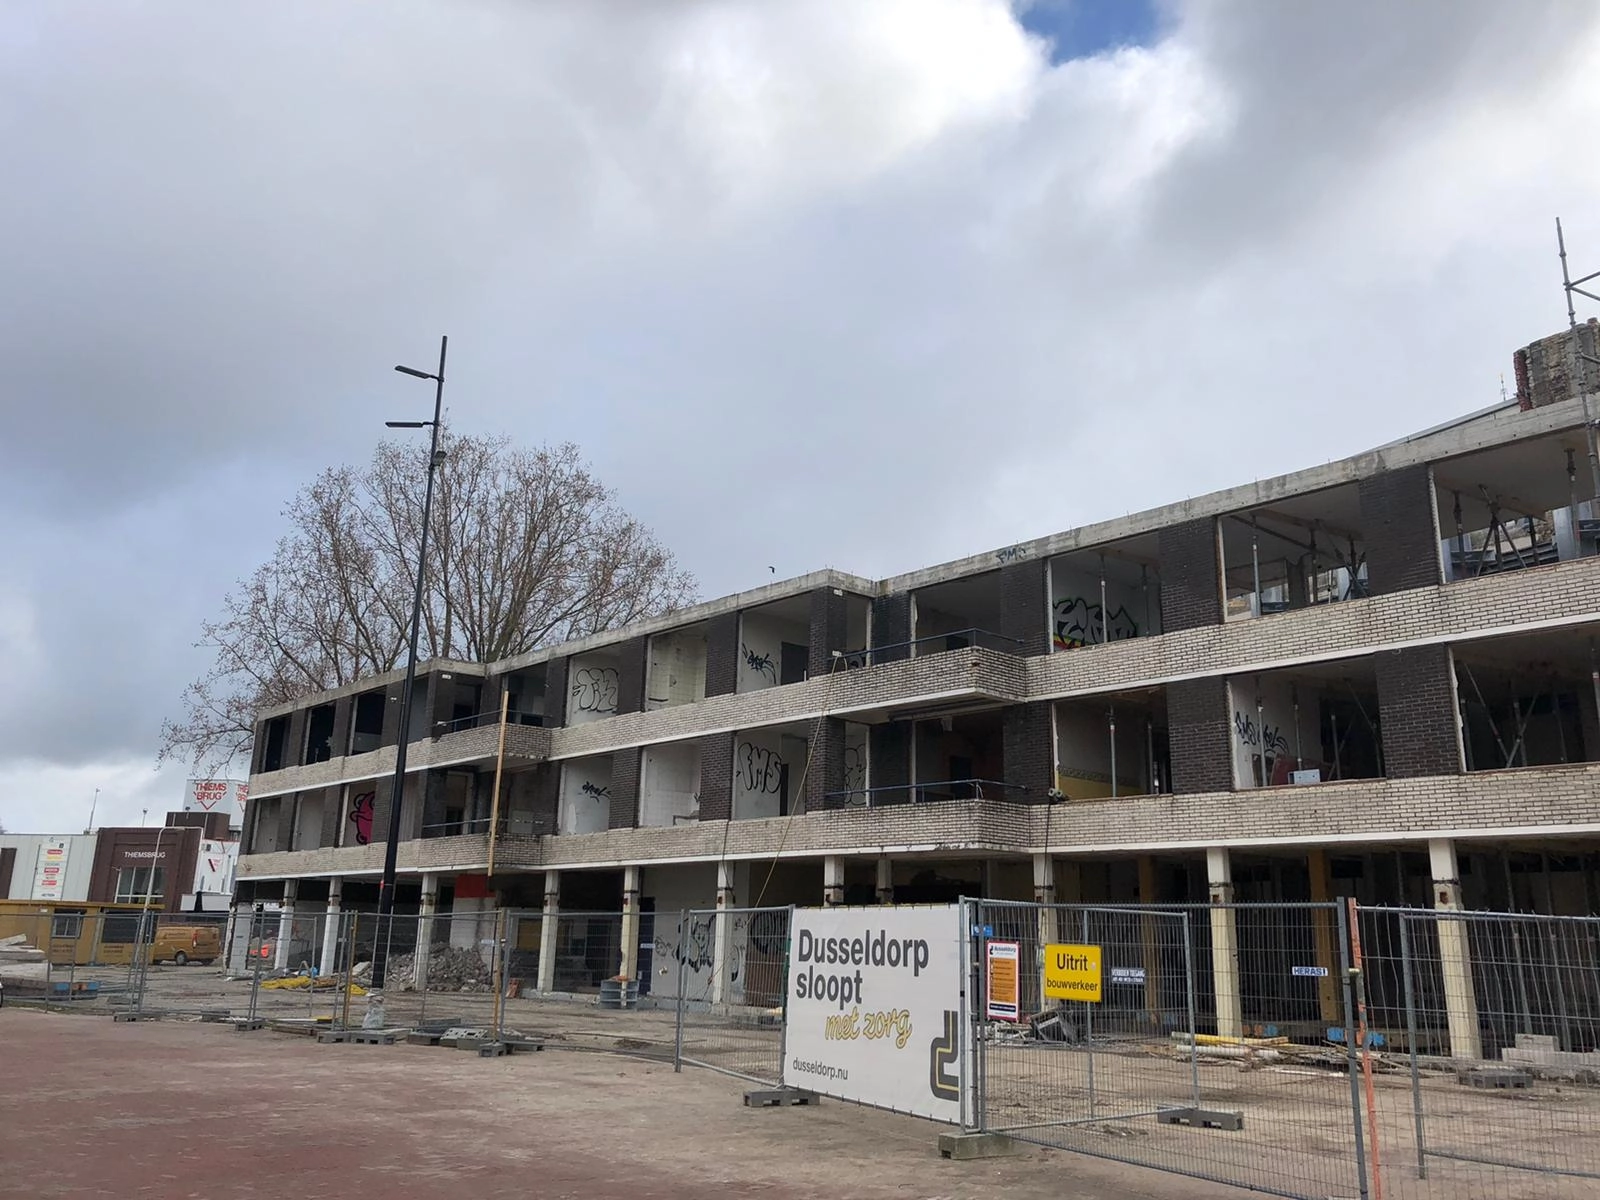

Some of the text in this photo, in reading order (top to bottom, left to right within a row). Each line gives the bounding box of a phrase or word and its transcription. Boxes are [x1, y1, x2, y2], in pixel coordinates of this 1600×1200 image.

[196, 791, 222, 800] BRUG
[798, 929, 929, 977] Dusseldorp
[1056, 953, 1088, 971] Uitrit
[796, 965, 863, 1010] sloopt
[1046, 977, 1098, 992] bouwverkeer
[825, 1005, 912, 1049] met zorg
[793, 1057, 849, 1080] dusseldorp.nu
